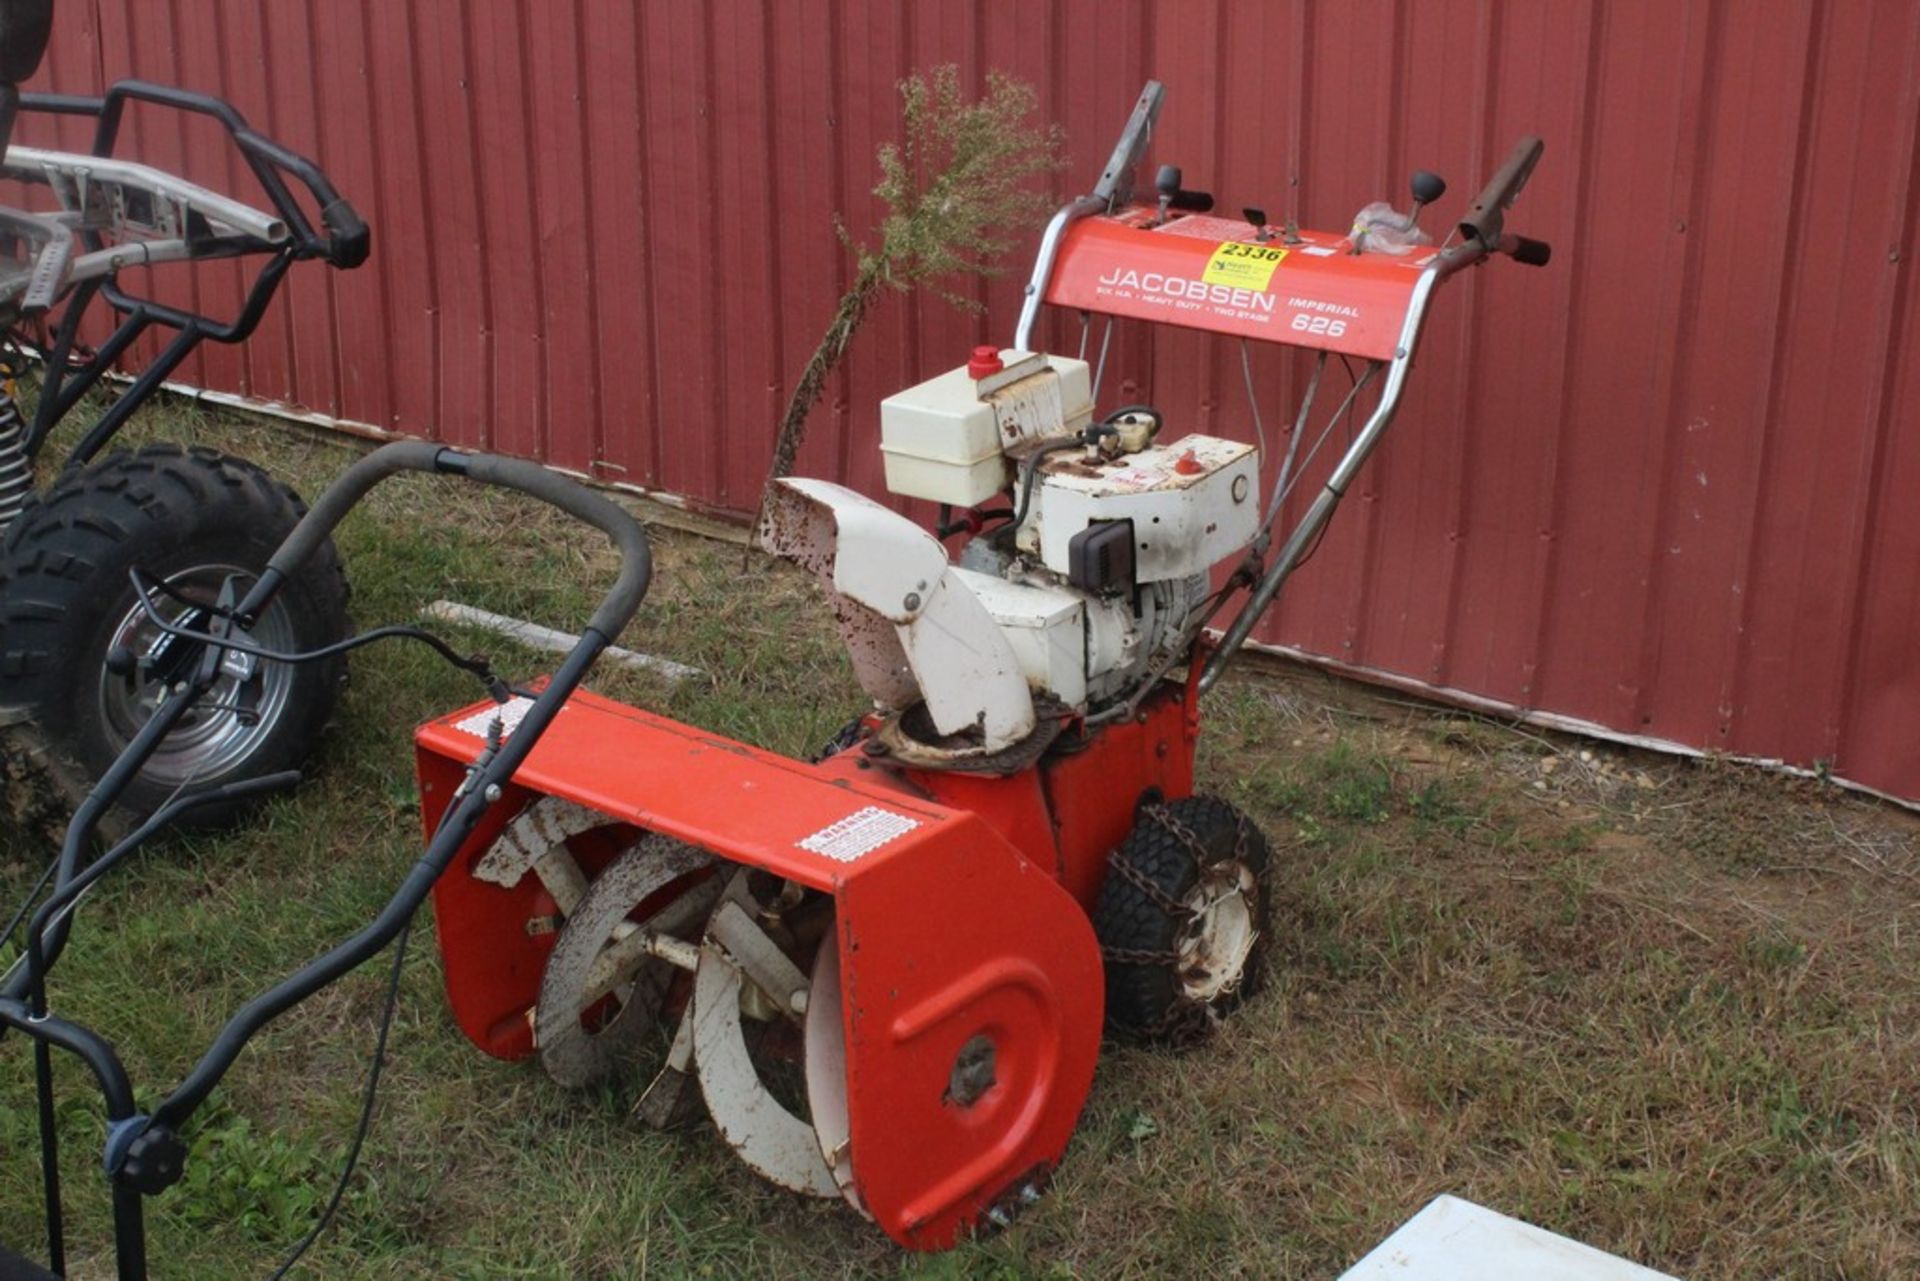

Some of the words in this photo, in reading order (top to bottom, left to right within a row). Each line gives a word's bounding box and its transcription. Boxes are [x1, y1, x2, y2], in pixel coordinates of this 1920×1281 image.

[1222, 243, 1283, 262] 2336
[1098, 267, 1276, 311] JACOBSEN
[1141, 292, 1173, 307] HEAVY
[1176, 300, 1203, 311] DUTY
[1287, 296, 1359, 318] IMPERIAL
[1290, 313, 1347, 337] 626
